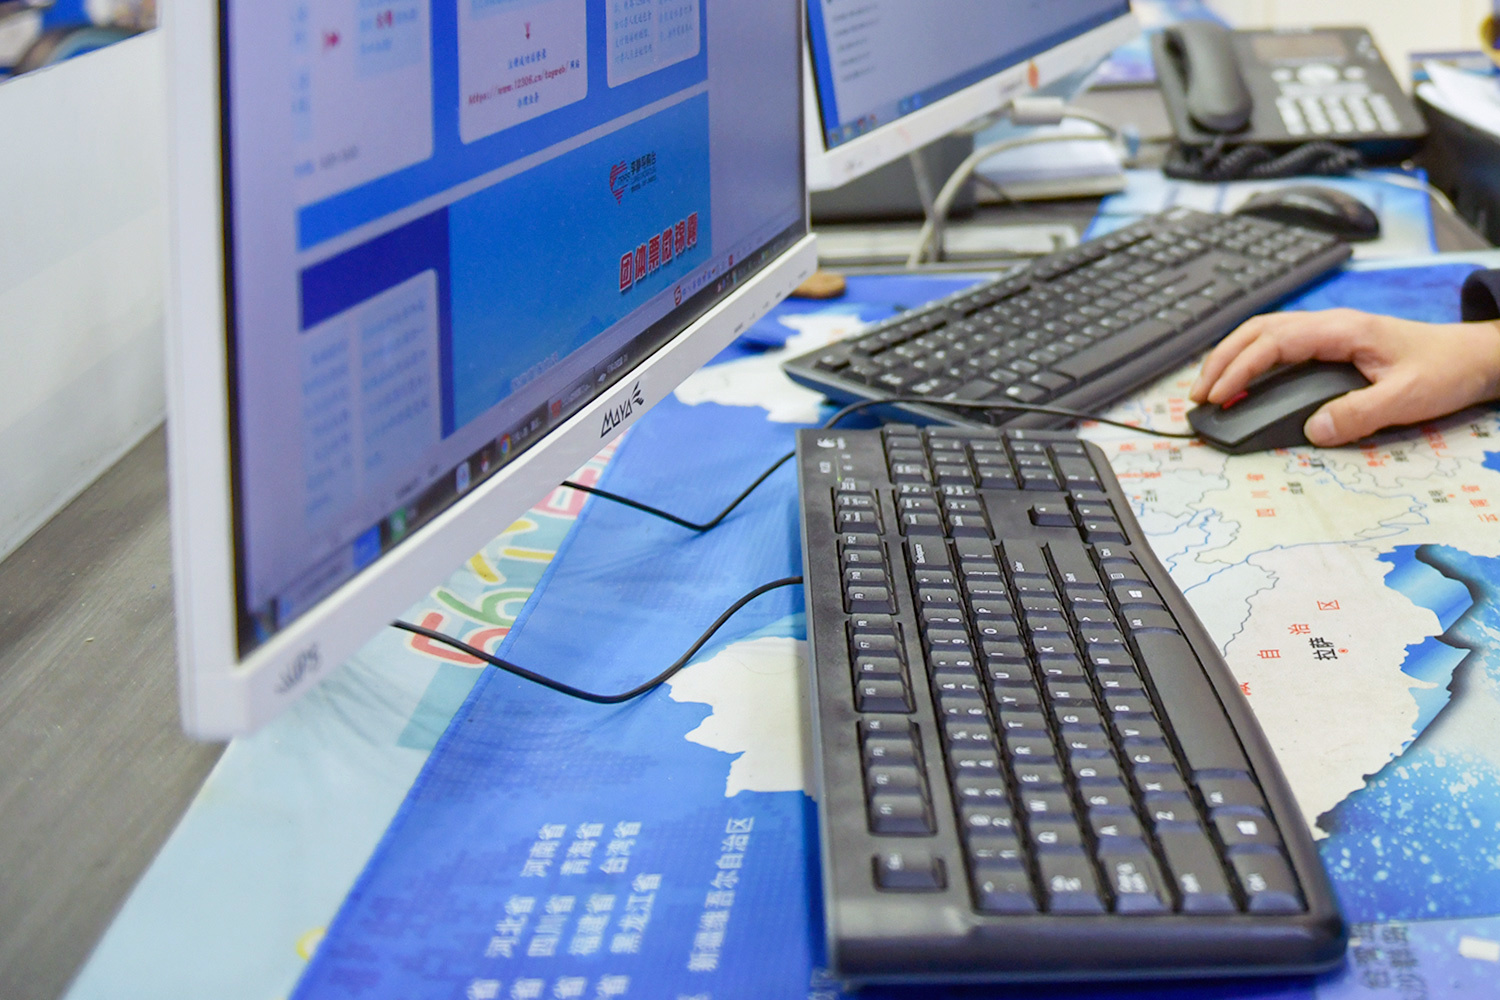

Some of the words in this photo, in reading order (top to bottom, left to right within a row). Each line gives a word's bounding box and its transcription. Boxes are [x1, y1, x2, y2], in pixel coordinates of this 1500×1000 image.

[1247, 473, 1277, 518] 四川省
[1461, 483, 1500, 523] 云南省
[1309, 637, 1339, 662] 拉萨
[519, 823, 567, 878] 河南省
[560, 822, 604, 876] 青海省
[600, 820, 642, 874] 台湾省
[609, 872, 662, 954] 黑龙江省
[687, 816, 755, 971] 新疆维吾尔自治区
[484, 894, 537, 958] 河北省
[527, 894, 577, 957] 四川省
[567, 893, 617, 956] 福建省
